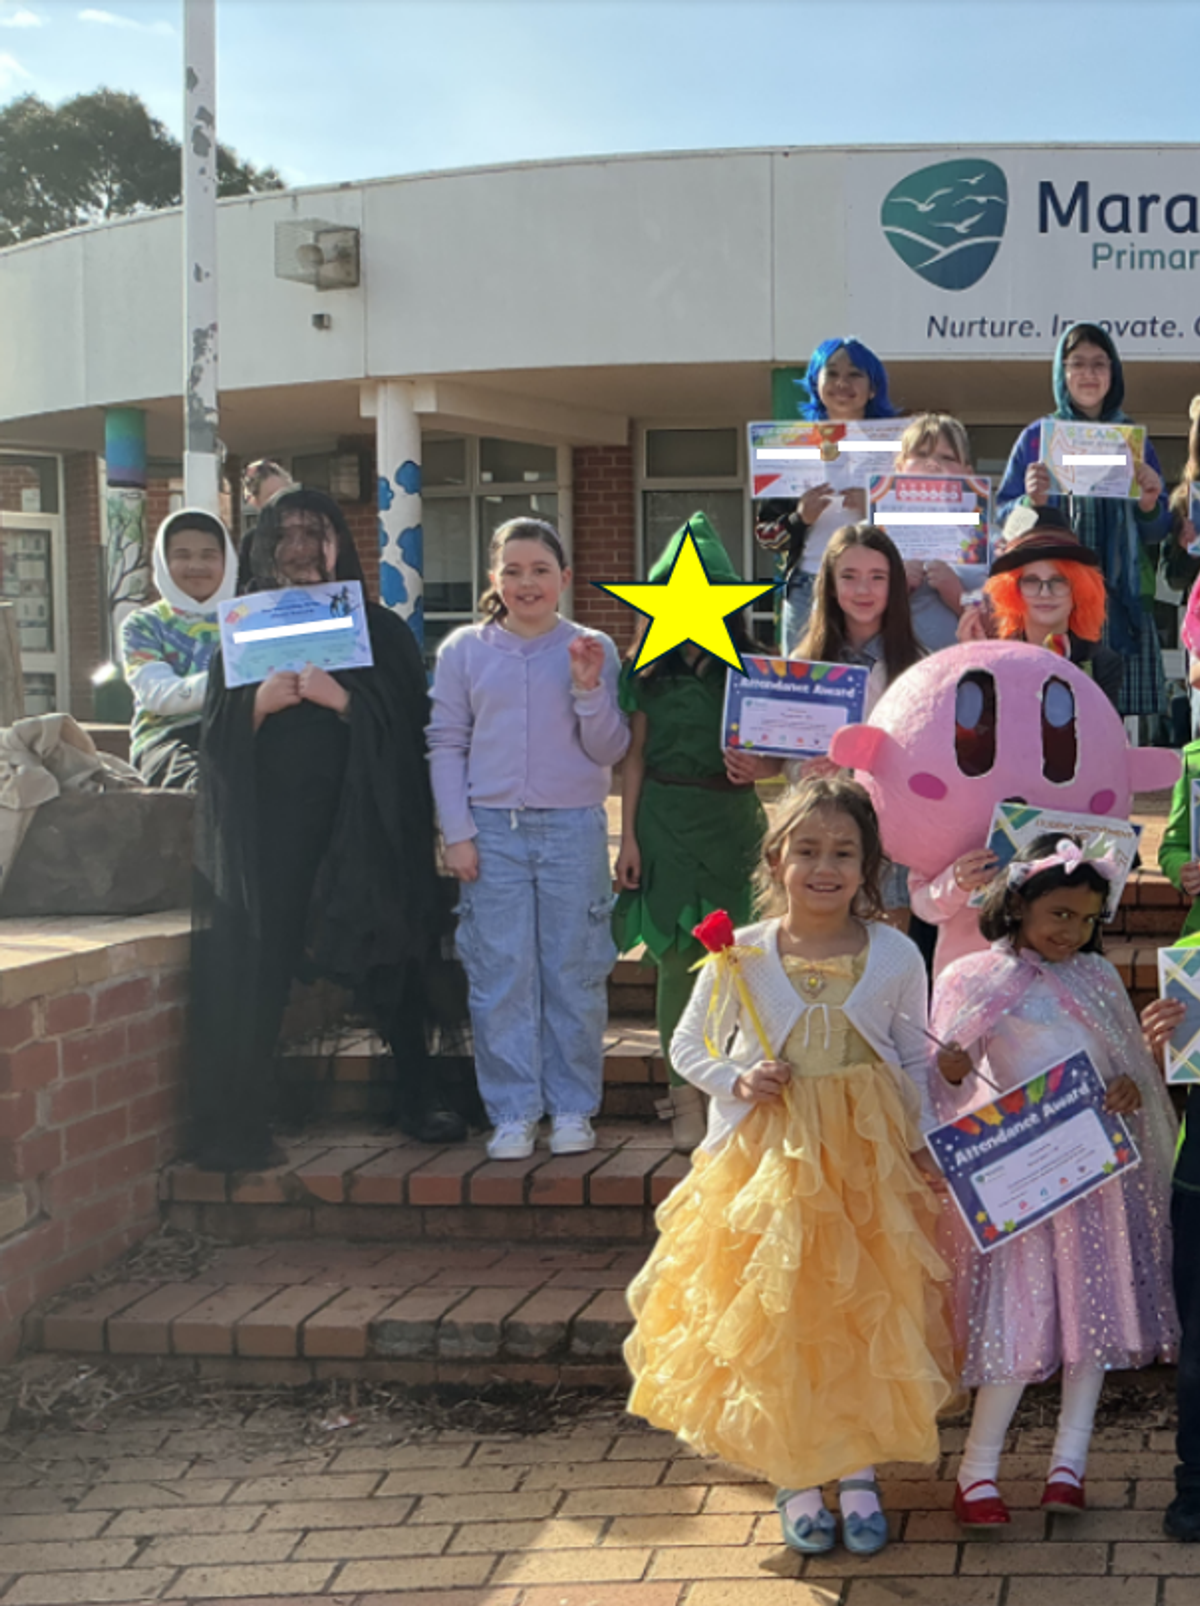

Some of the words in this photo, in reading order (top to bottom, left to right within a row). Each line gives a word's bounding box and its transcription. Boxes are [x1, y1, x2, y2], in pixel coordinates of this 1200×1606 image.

[927, 315, 1041, 339] Nurture.
[1052, 313, 1184, 338] Iovate.
[812, 683, 855, 698] Award
[954, 1112, 1042, 1167] Attendance
[1041, 1081, 1091, 1118] Award
